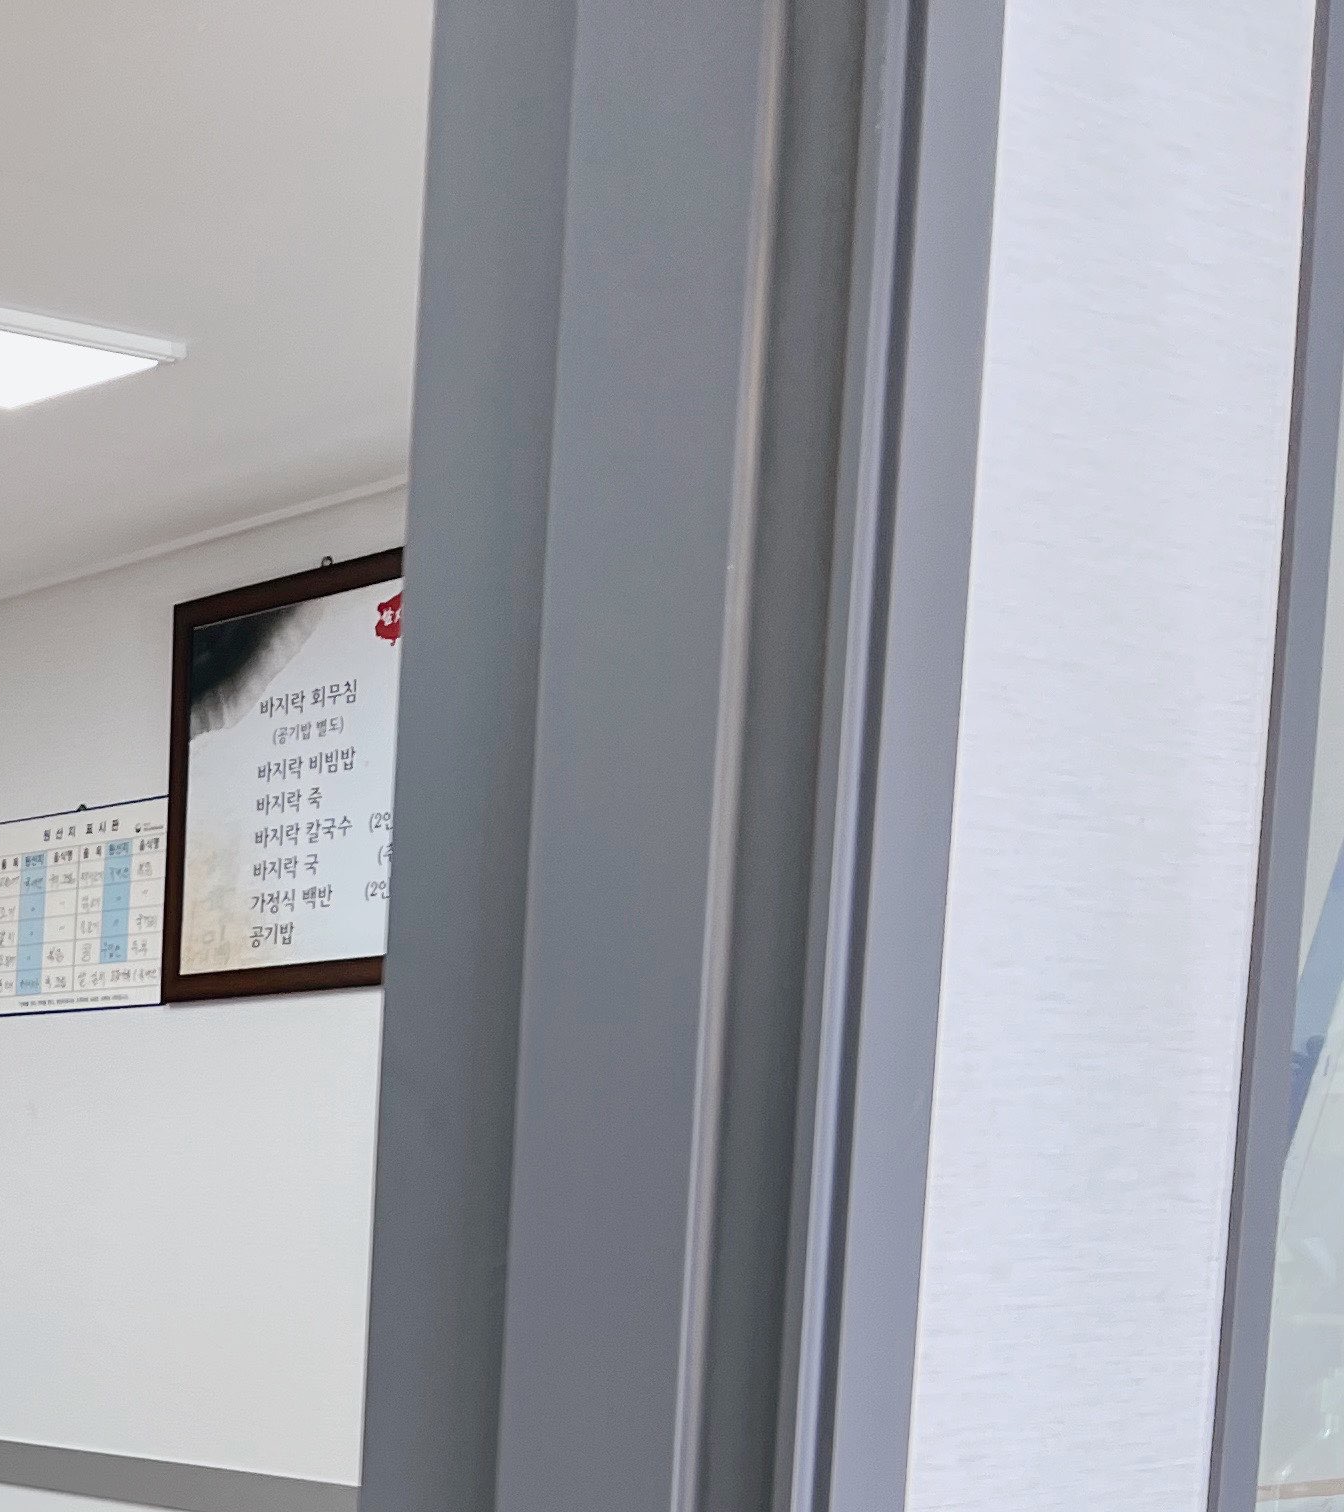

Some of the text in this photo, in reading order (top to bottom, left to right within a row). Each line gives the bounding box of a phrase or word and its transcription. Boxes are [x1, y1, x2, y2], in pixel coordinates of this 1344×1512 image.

[259, 679, 358, 718] 바지락 회무침
[272, 716, 344, 745] (공기밥 별도)
[257, 746, 356, 782] 바지락 비빔밥
[256, 787, 323, 815] 바지락 죽
[254, 822, 300, 849] 바지락
[306, 815, 353, 844] 칼국수
[252, 854, 319, 881] 바지락 국
[250, 888, 296, 914] 가정식
[302, 884, 332, 909] 백반
[249, 922, 294, 948] 공기밥
